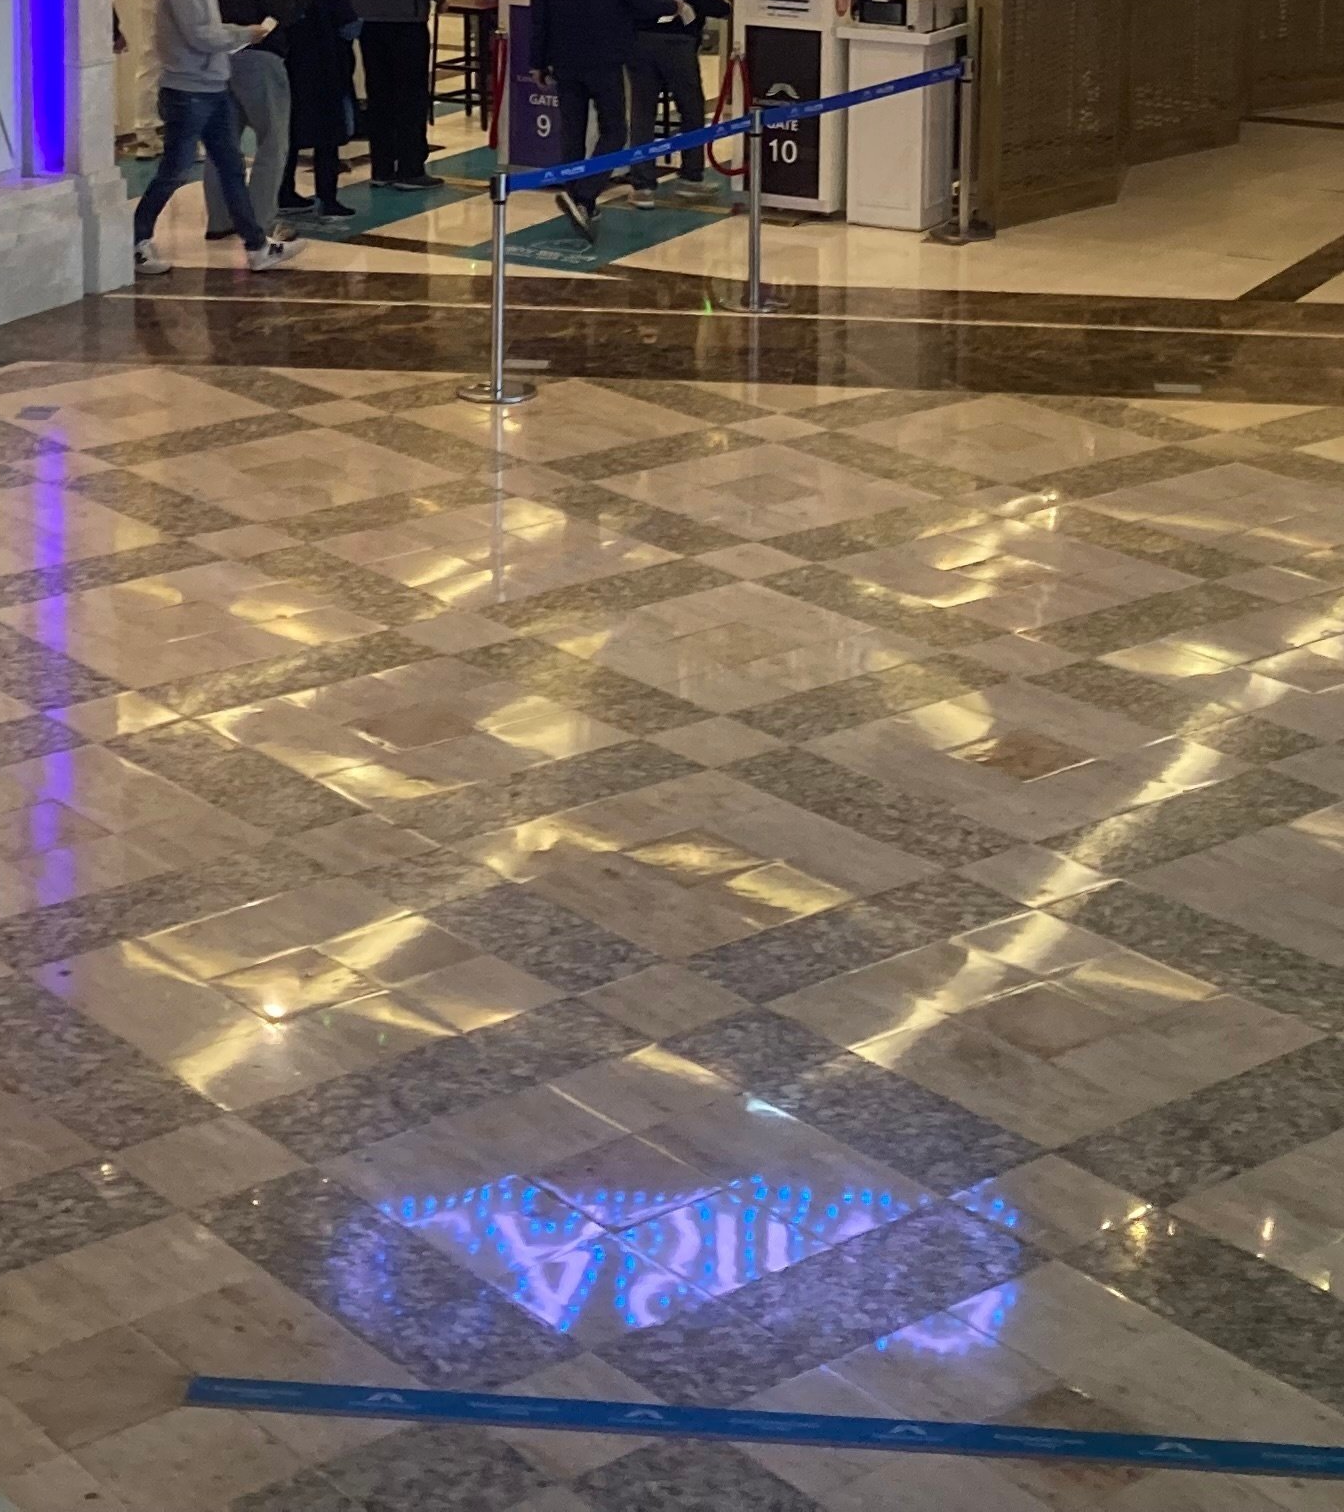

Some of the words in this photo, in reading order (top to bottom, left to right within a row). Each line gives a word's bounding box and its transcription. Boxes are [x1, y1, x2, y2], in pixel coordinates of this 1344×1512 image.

[528, 93, 560, 108] GATE
[536, 114, 551, 137] 9
[768, 138, 798, 164] 10
